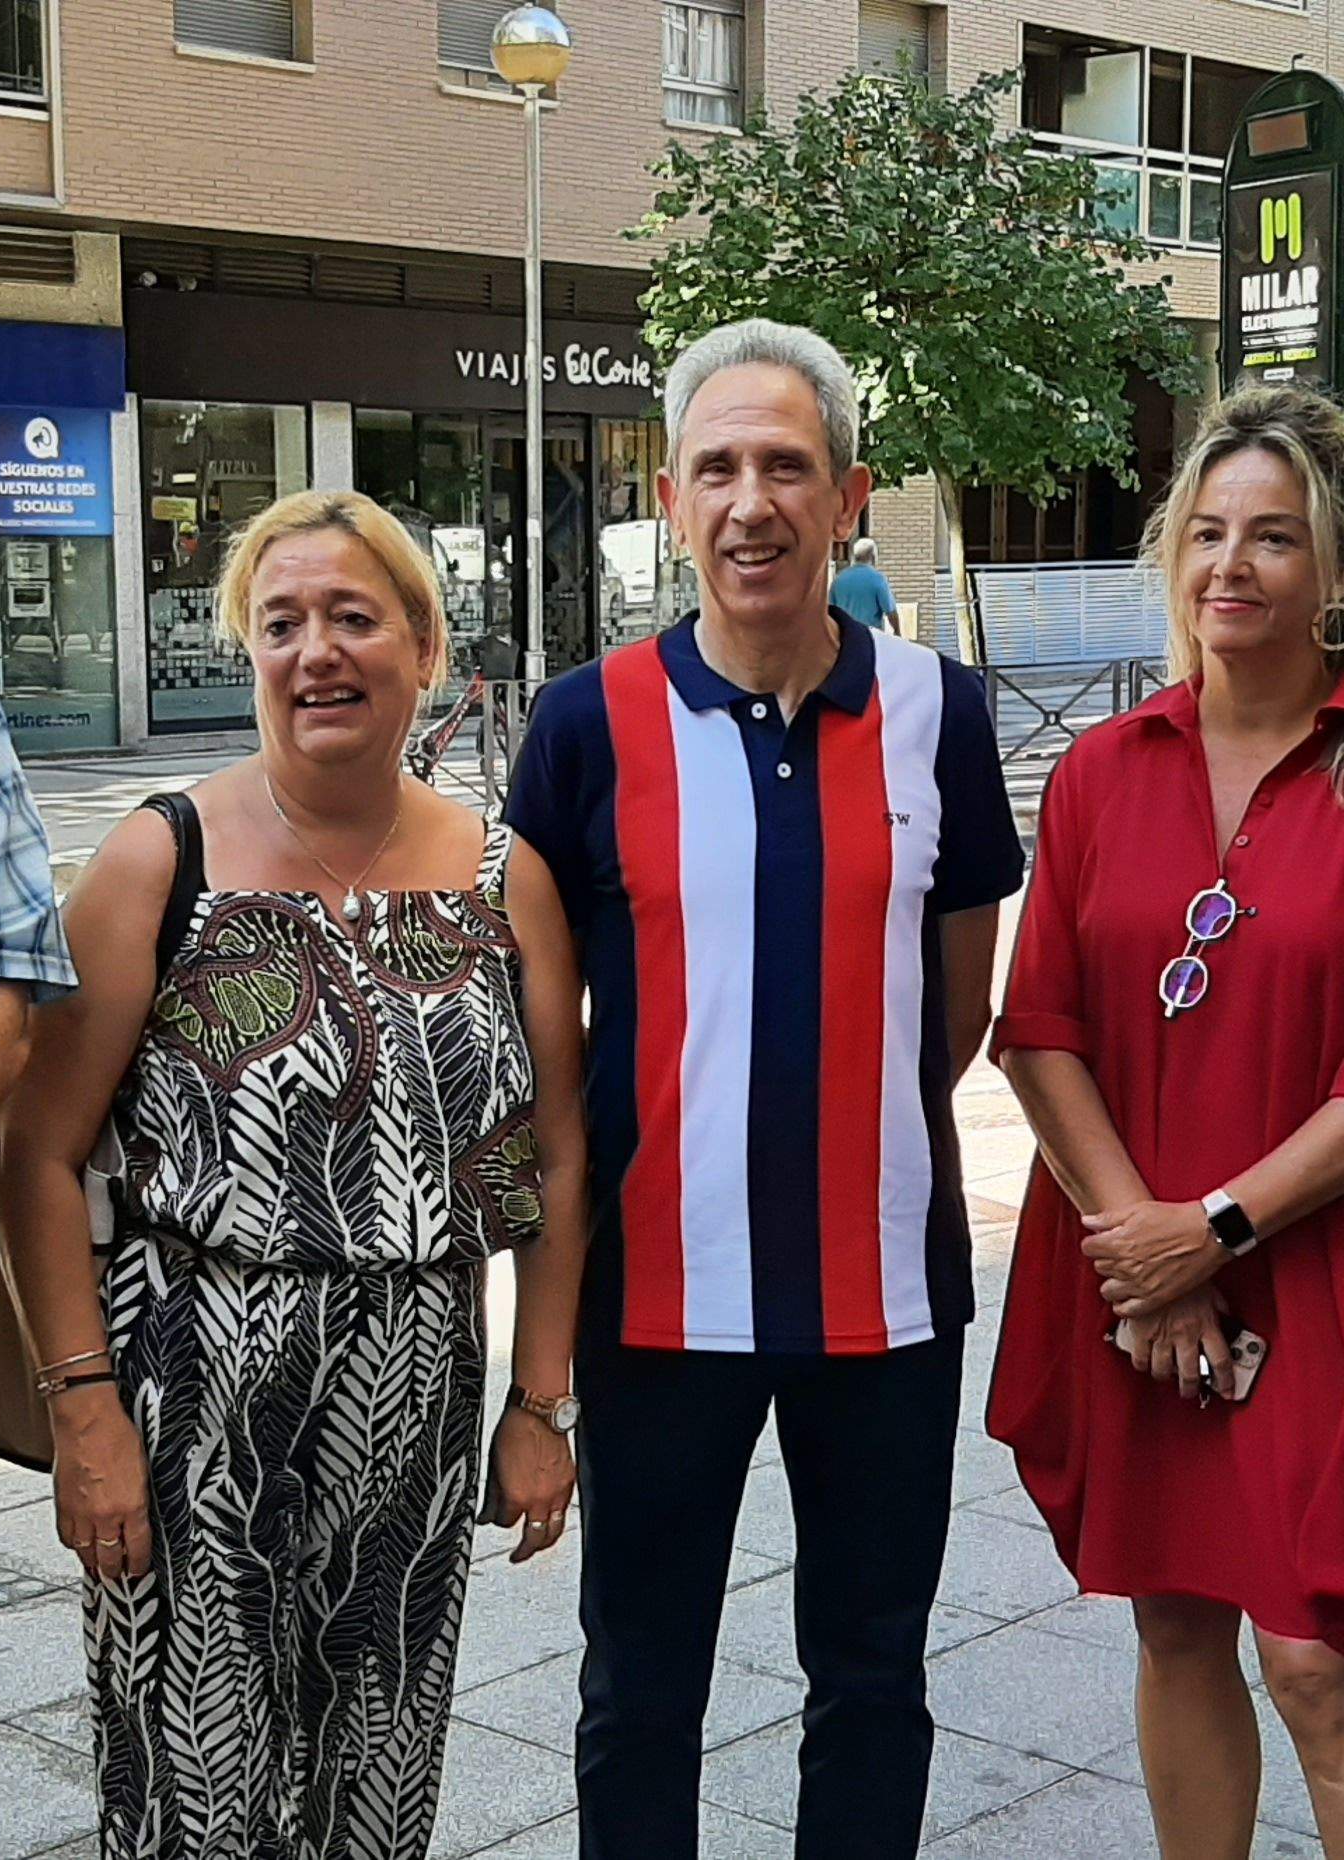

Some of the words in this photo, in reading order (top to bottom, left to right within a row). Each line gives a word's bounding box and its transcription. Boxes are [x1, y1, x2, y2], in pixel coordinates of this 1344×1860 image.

[1241, 266, 1319, 312] MILAR
[455, 350, 556, 386] VIAJS
[66, 466, 85, 478] EN
[56, 482, 96, 497] REDES
[13, 500, 75, 514] SOCIALES
